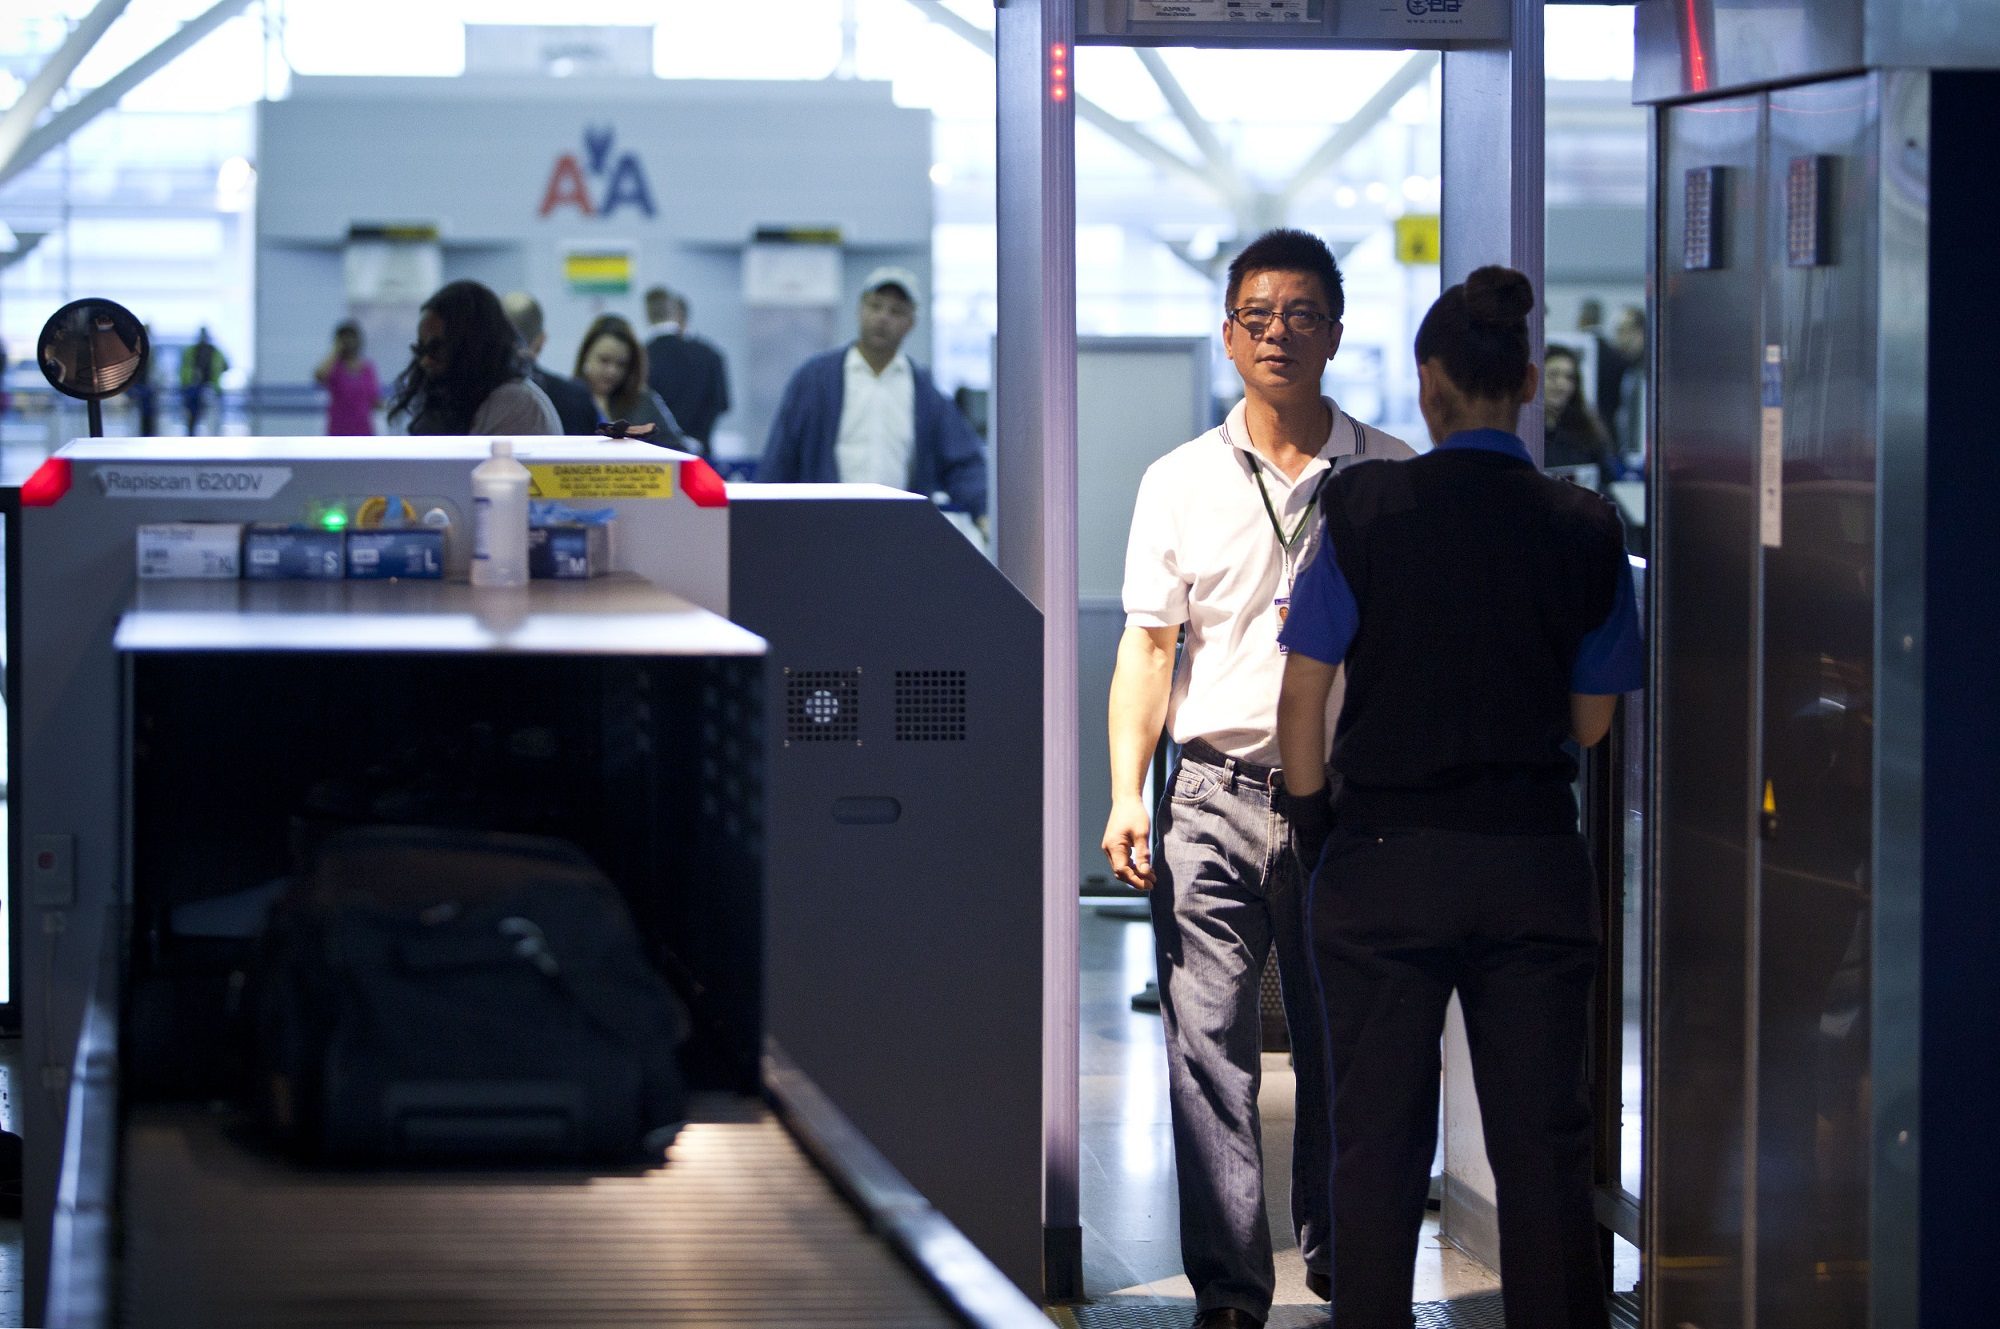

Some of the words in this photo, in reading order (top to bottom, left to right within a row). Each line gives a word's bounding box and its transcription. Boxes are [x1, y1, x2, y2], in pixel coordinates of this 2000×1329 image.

[553, 464, 600, 475] DANGER
[605, 464, 665, 474] RADIATION
[107, 471, 191, 493] Rapiscan
[197, 472, 263, 492] 620DV
[323, 549, 338, 573] S
[424, 548, 438, 572] L
[569, 557, 586, 573] M
